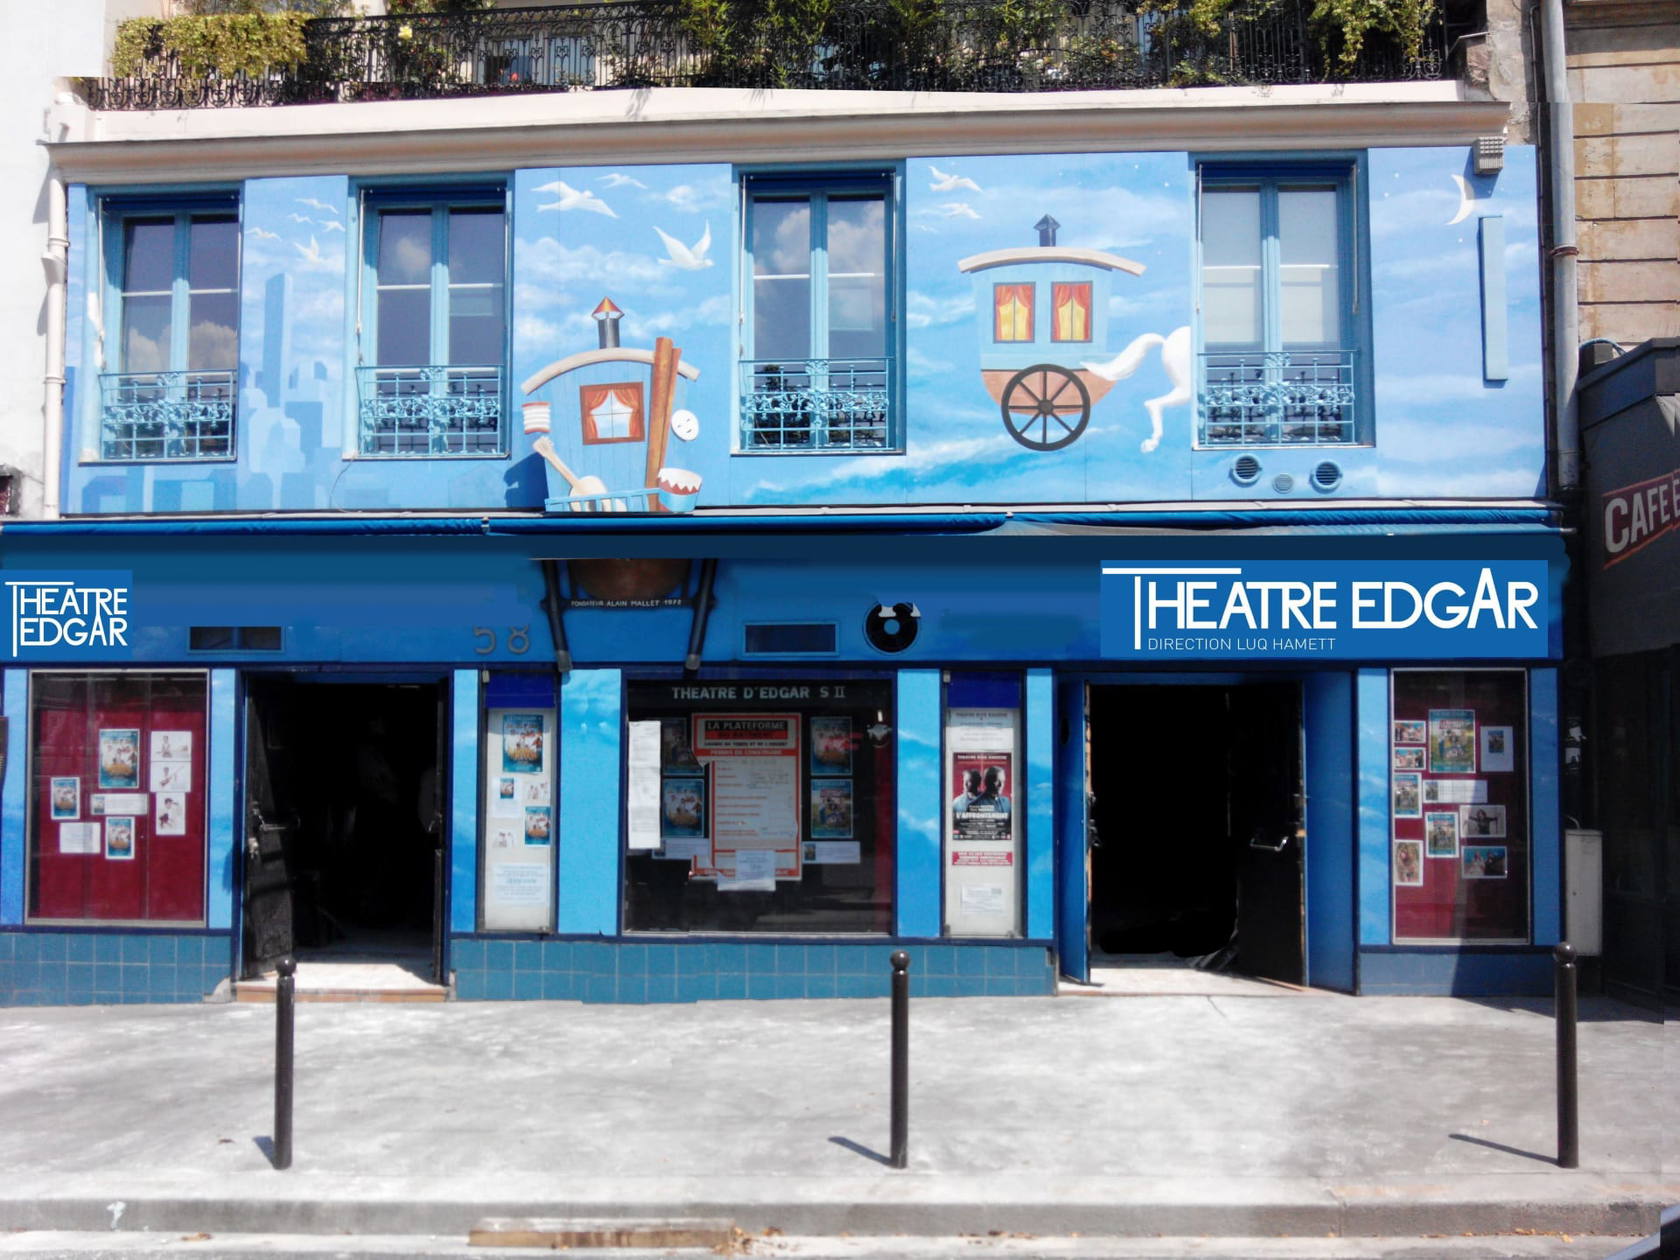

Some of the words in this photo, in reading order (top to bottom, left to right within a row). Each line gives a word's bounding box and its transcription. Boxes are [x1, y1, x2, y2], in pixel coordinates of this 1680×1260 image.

[630, 599, 660, 607] MALLET
[1102, 568, 1337, 650] THEATRE
[1352, 568, 1539, 629] EDGAR
[20, 614, 128, 646] EDGAR
[1148, 638, 1231, 651] DIRECTION
[1237, 638, 1268, 651] LUQ
[1273, 638, 1336, 651] HAMETT
[672, 686, 737, 700] THEATRE
[743, 686, 810, 700] D'EDGAR
[707, 722, 720, 730] LA
[724, 721, 785, 730] PLATEFORME
